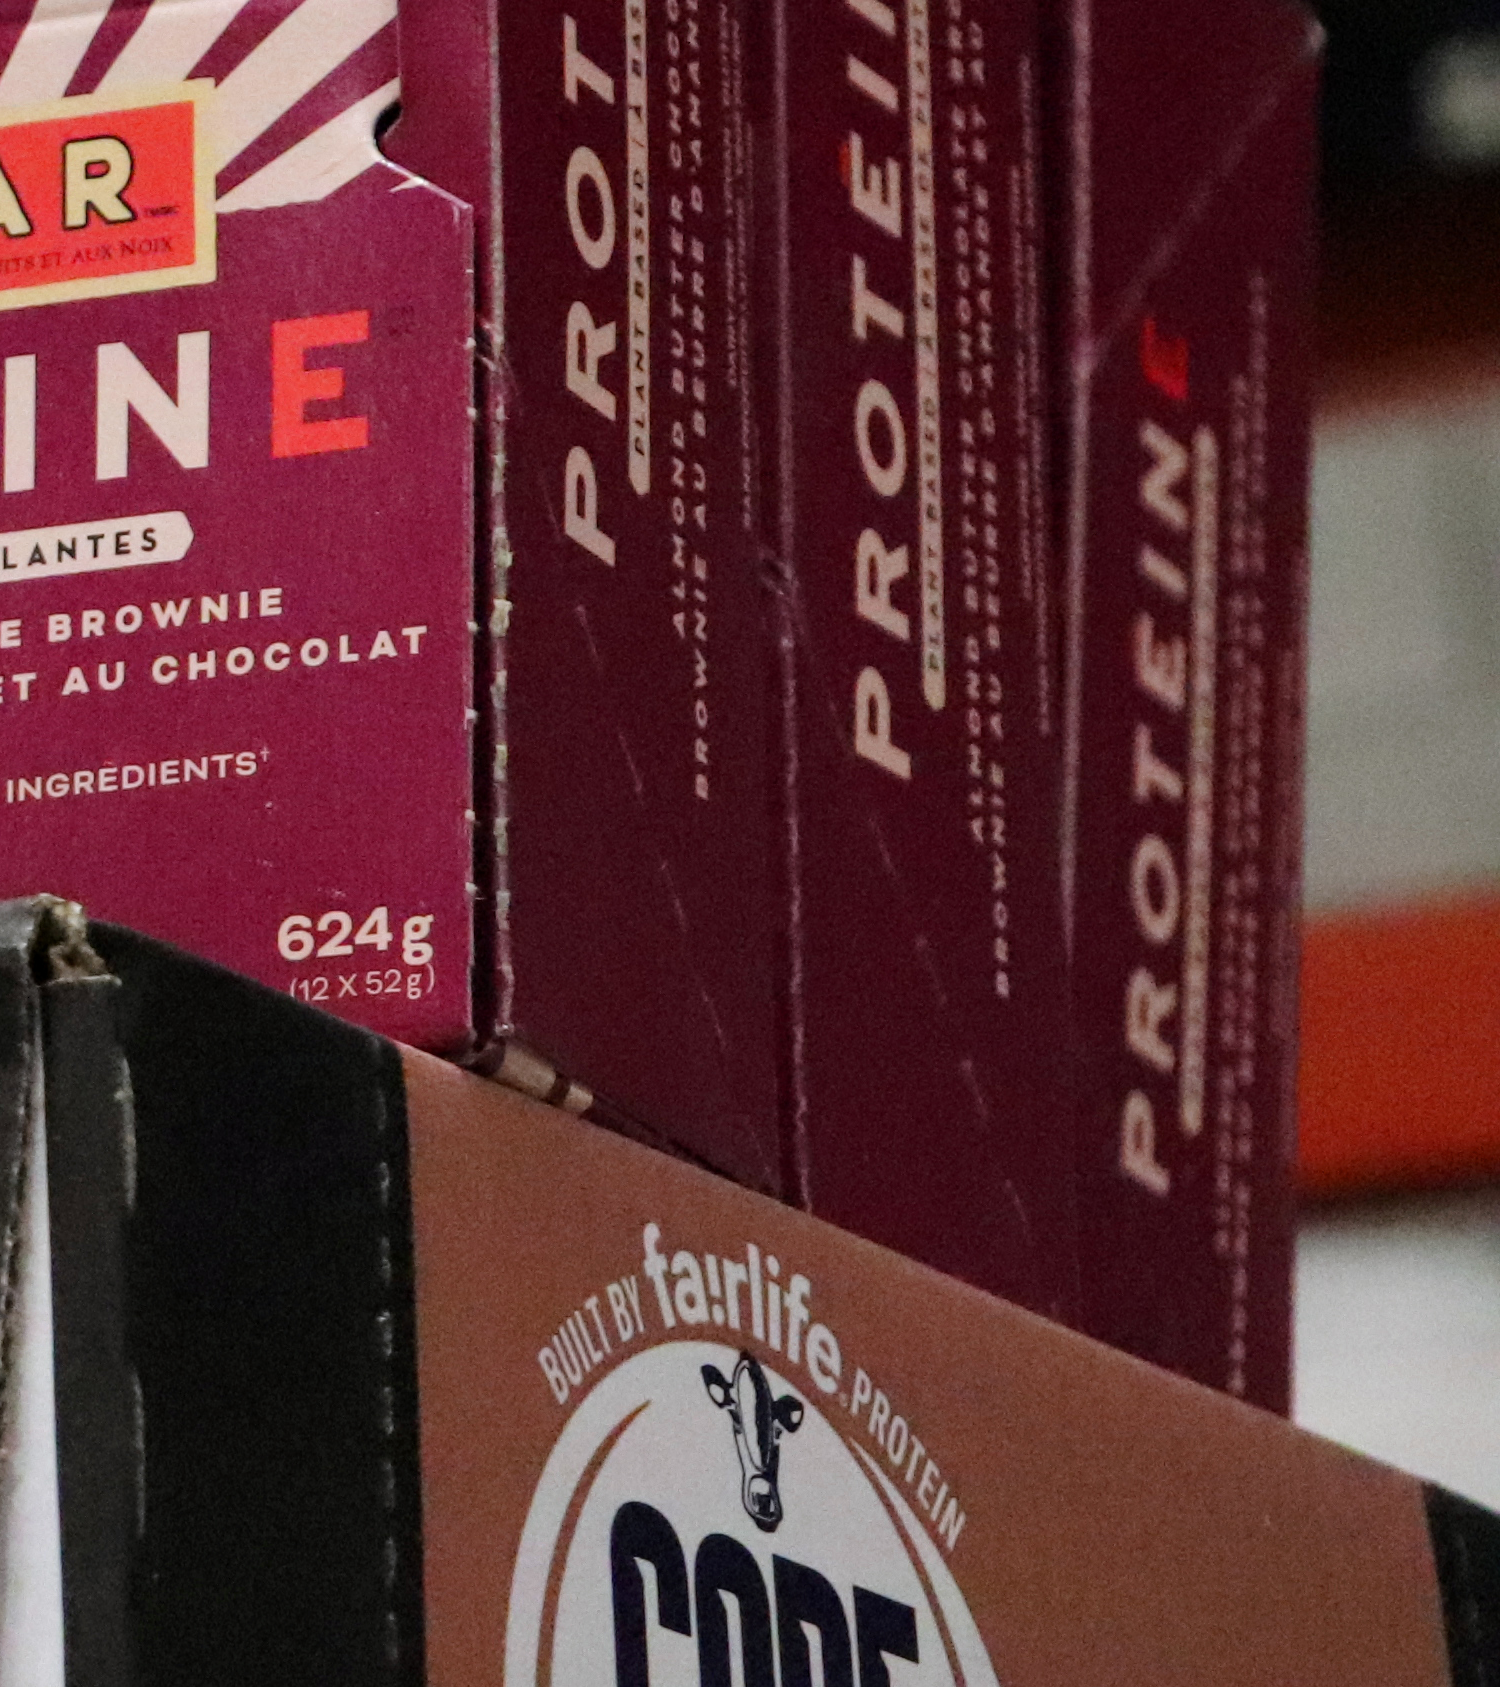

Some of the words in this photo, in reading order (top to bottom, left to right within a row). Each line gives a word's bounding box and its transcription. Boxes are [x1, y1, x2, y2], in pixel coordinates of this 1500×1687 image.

[629, 170, 649, 312] BASED
[669, 196, 687, 398] BUTTER
[630, 324, 649, 458] PLANT
[688, 230, 708, 438] BEURRE
[671, 425, 689, 641] ALMOND
[690, 462, 708, 532] AU
[47, 585, 285, 642] BROWNIE
[60, 659, 128, 697] AU
[151, 623, 430, 687] CHOCOLAT
[690, 552, 710, 802] BROWNIE
[537, 1293, 616, 1406] BUILT
[613, 1274, 644, 1341] BY
[850, 1370, 967, 1551] PROTEIN
